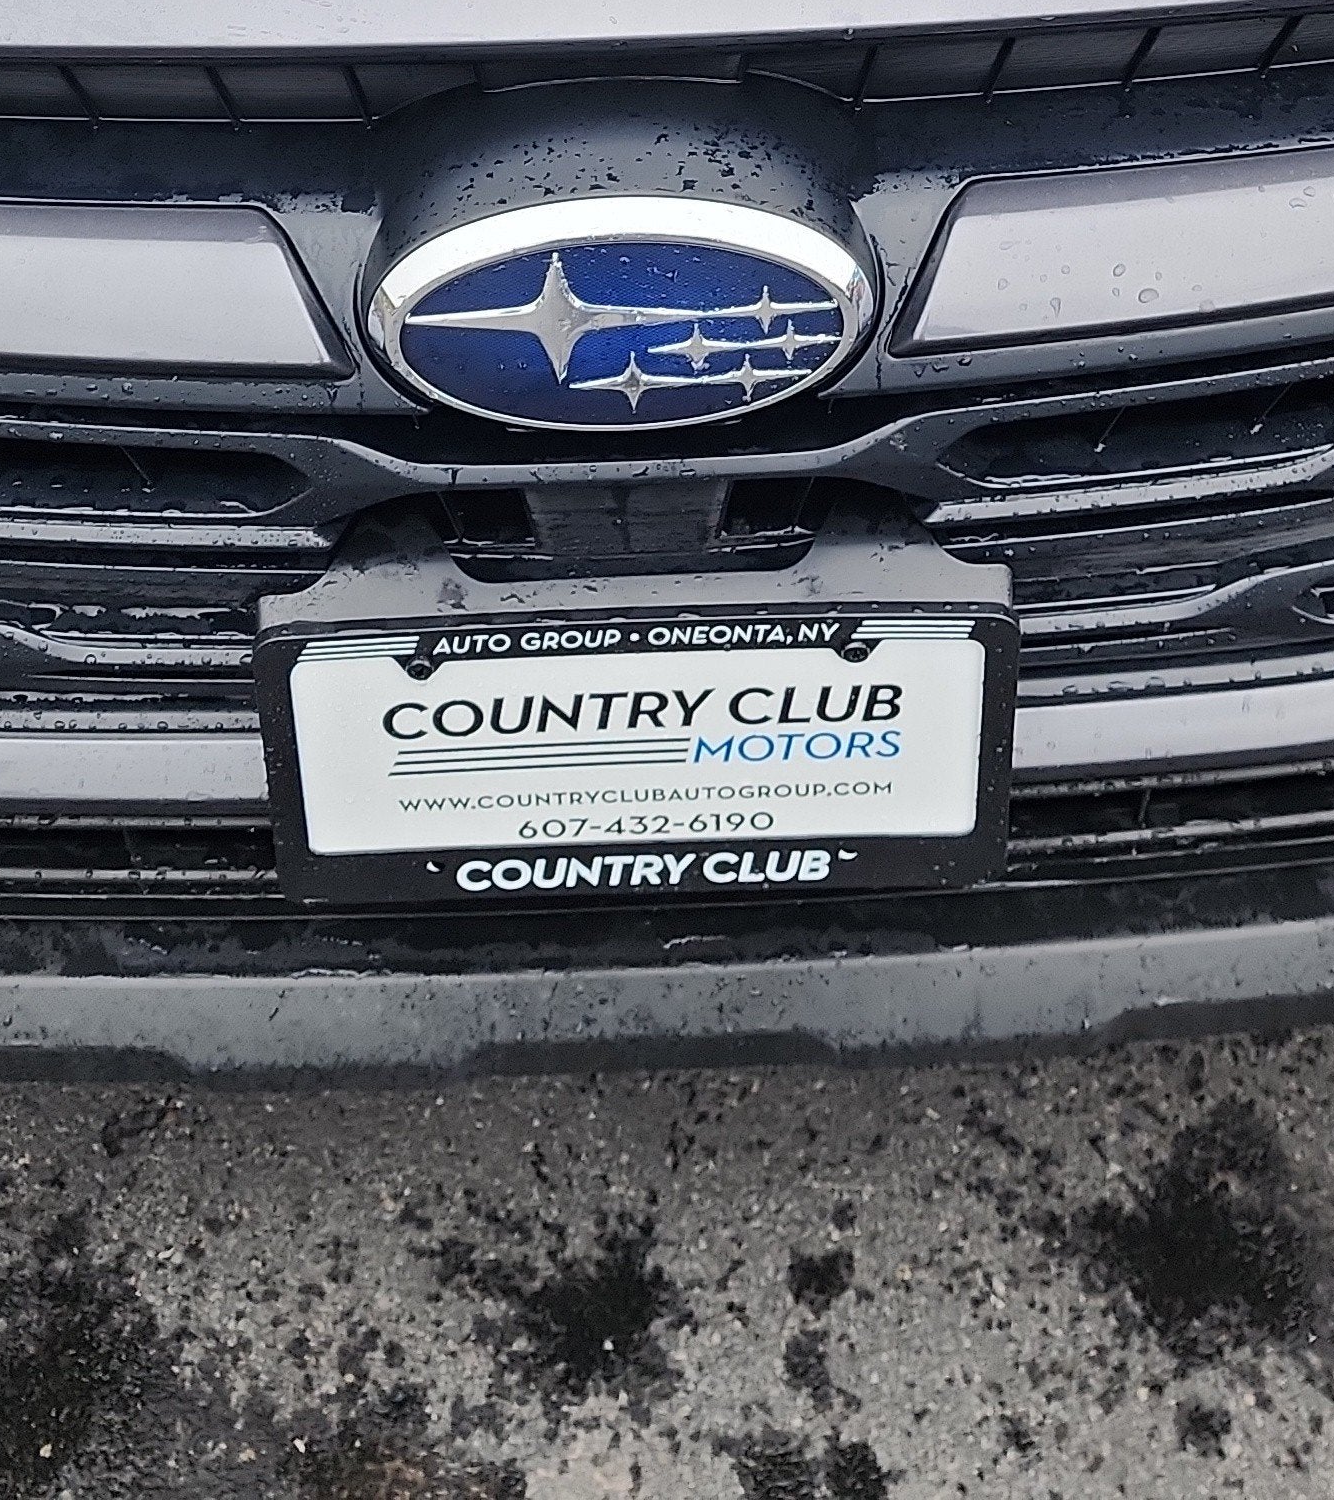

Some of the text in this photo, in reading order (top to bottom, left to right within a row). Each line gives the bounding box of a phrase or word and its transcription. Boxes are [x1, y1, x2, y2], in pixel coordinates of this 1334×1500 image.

[432, 622, 840, 656] AUTO GROUP ONEONTA, NY
[382, 684, 903, 740] COUNTRY CLUB
[693, 730, 902, 764] MOTORS
[398, 781, 892, 813] WWW.COUNTRYCLUBAUTOGROUP.COM
[518, 811, 774, 839] 607-432-6190
[456, 849, 831, 892] COUNTRY CLUB
